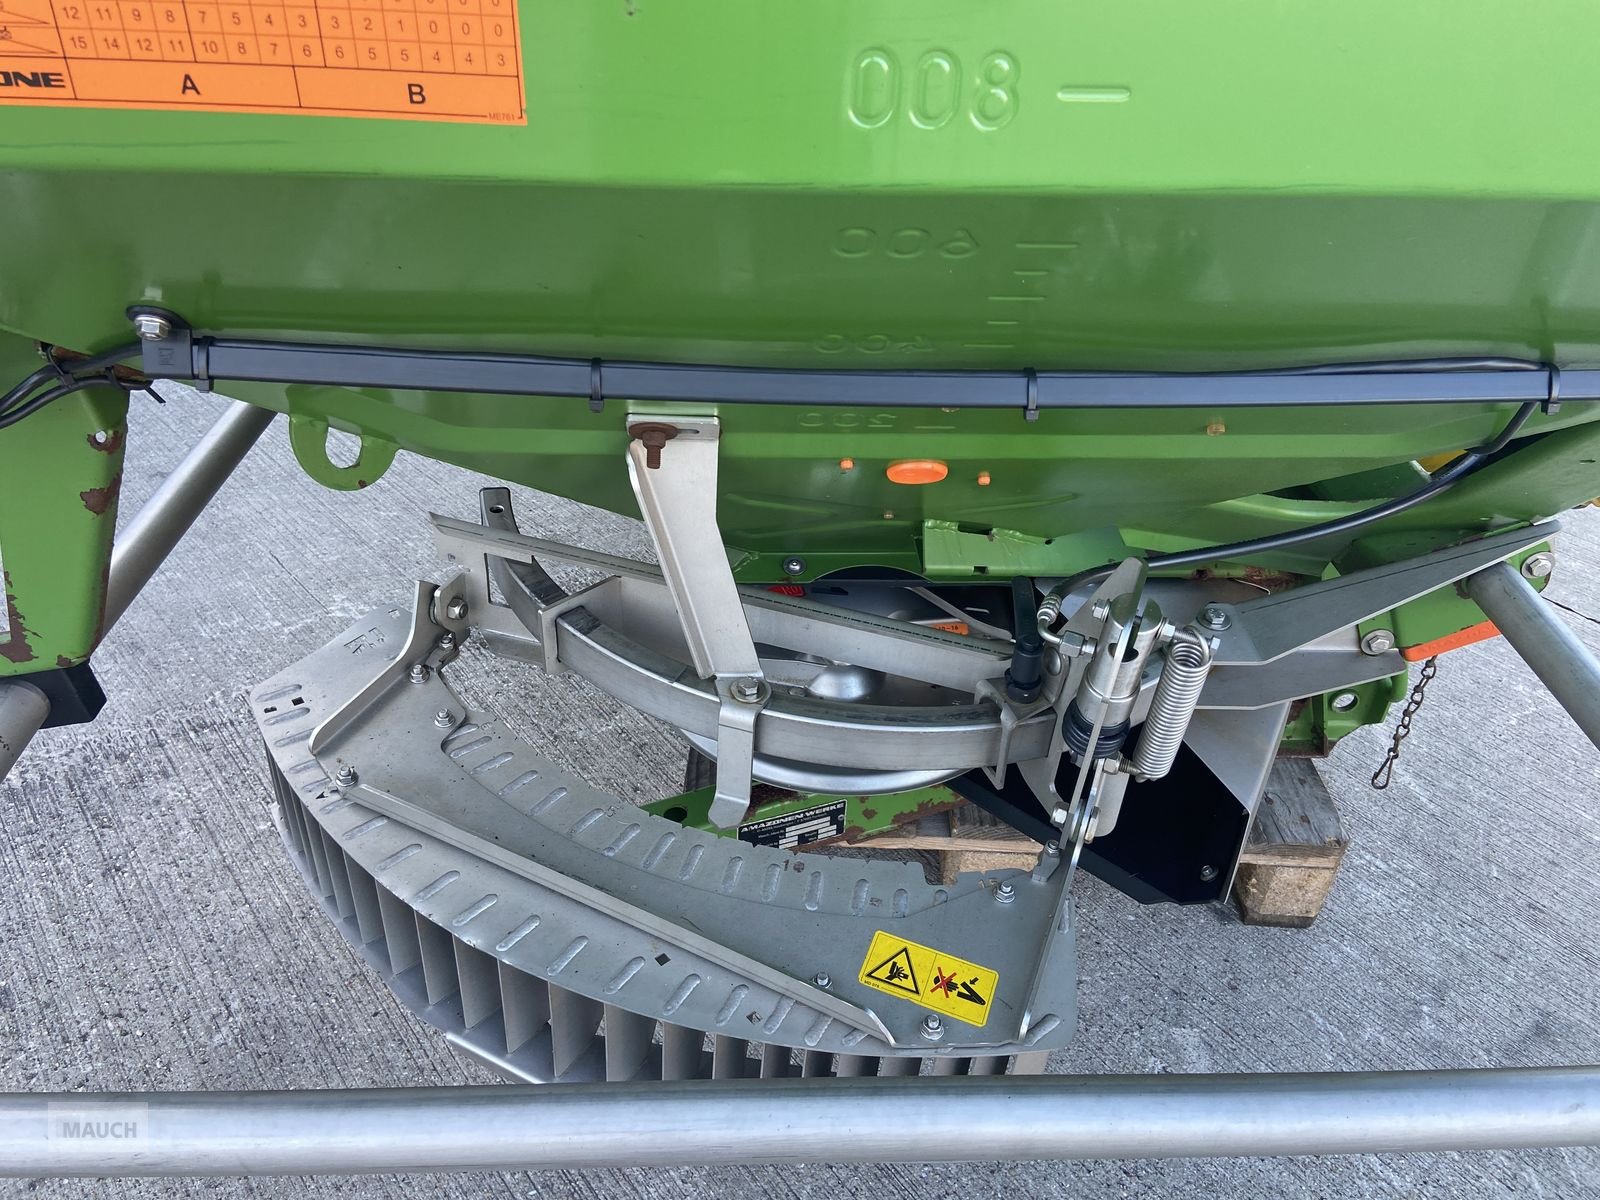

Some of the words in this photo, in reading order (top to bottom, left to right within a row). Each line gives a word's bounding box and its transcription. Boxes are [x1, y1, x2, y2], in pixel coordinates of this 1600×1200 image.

[62, 6, 80, 20] 12
[96, 7, 112, 21] 11
[132, 8, 142, 22] 9
[166, 10, 176, 23] 8
[198, 11, 207, 24] 7
[231, 12, 241, 25] 5
[264, 13, 274, 25] 4
[298, 14, 308, 28] 3
[331, 16, 341, 29] 3
[363, 17, 373, 31] 2
[397, 19, 404, 33] 1
[429, 20, 438, 34] 0
[461, 22, 470, 36] 0
[494, 23, 503, 37] 0
[69, 36, 88, 49] 15
[103, 37, 120, 50] 14
[136, 38, 153, 51] 12
[169, 40, 185, 53] 11
[201, 41, 219, 54] 10
[237, 42, 247, 55] 8
[269, 43, 278, 56] 7
[302, 44, 312, 57] 6
[335, 46, 345, 59] 6
[367, 47, 377, 61] 5
[400, 49, 410, 62] 5
[432, 50, 441, 63] 4
[465, 52, 473, 65] 4
[497, 53, 506, 67] 3
[181, 73, 201, 96] A
[407, 83, 427, 105] B
